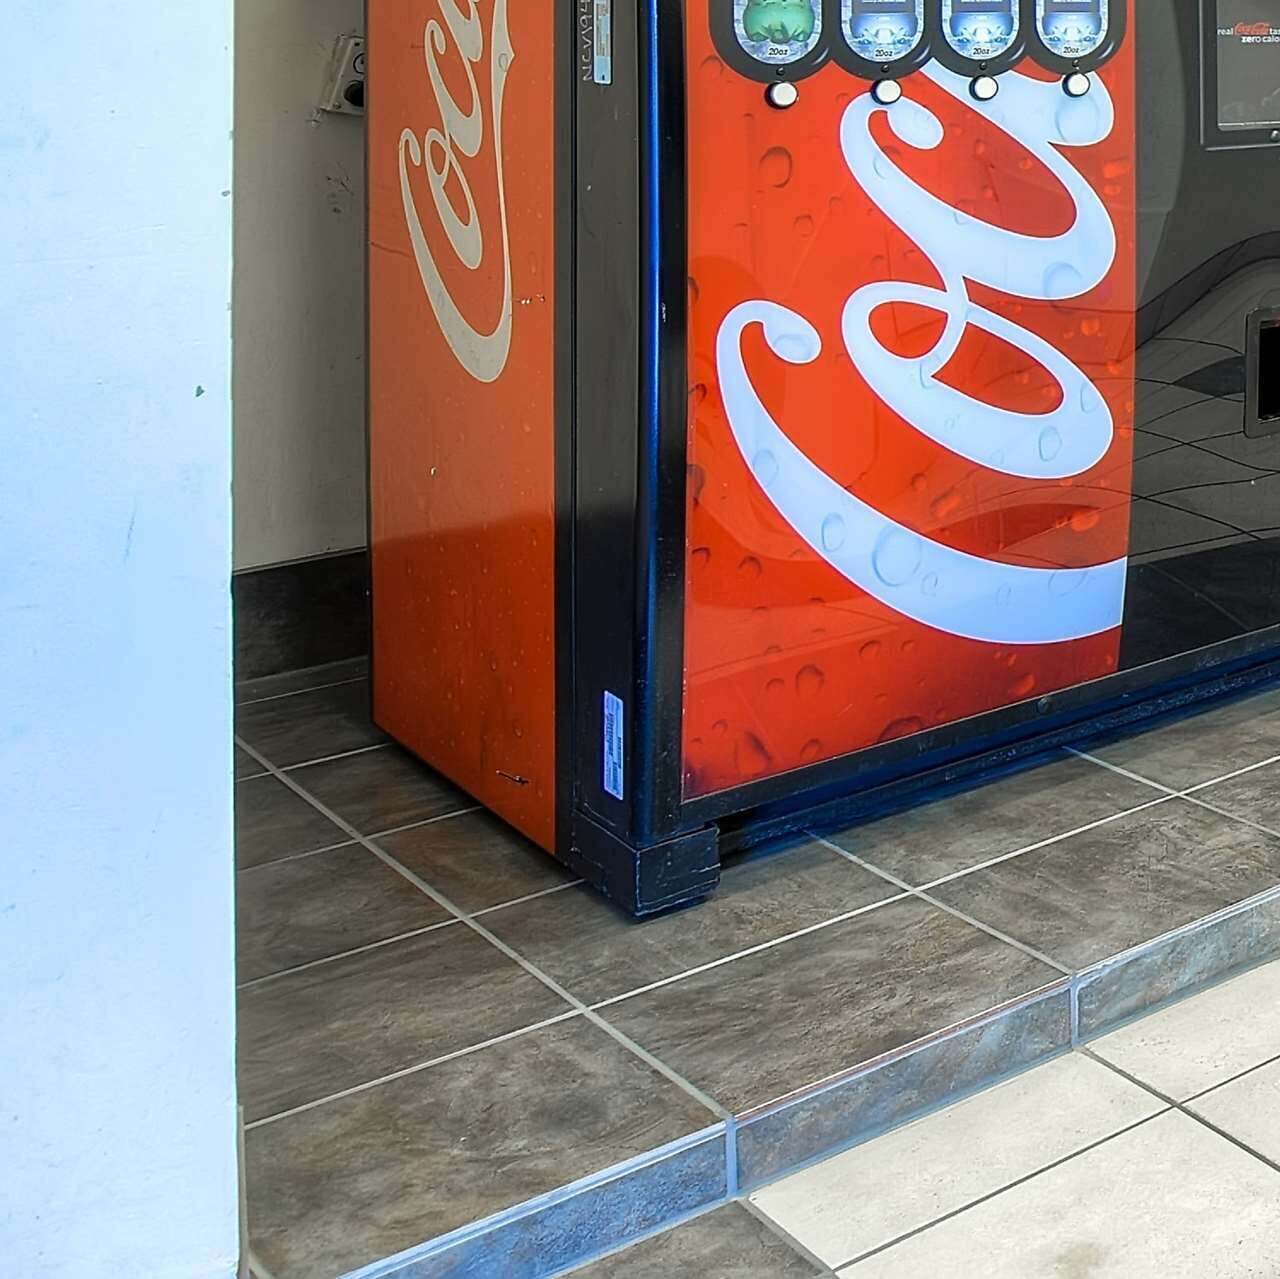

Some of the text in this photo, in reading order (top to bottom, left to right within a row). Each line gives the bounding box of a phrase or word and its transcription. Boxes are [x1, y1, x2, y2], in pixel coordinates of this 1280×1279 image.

[1217, 27, 1233, 36] real
[1241, 36, 1261, 44] zero
[768, 47, 788, 57] 20oz
[875, 47, 893, 57] 20oz
[973, 46, 990, 56] 20oz
[1063, 45, 1079, 54] 20oz
